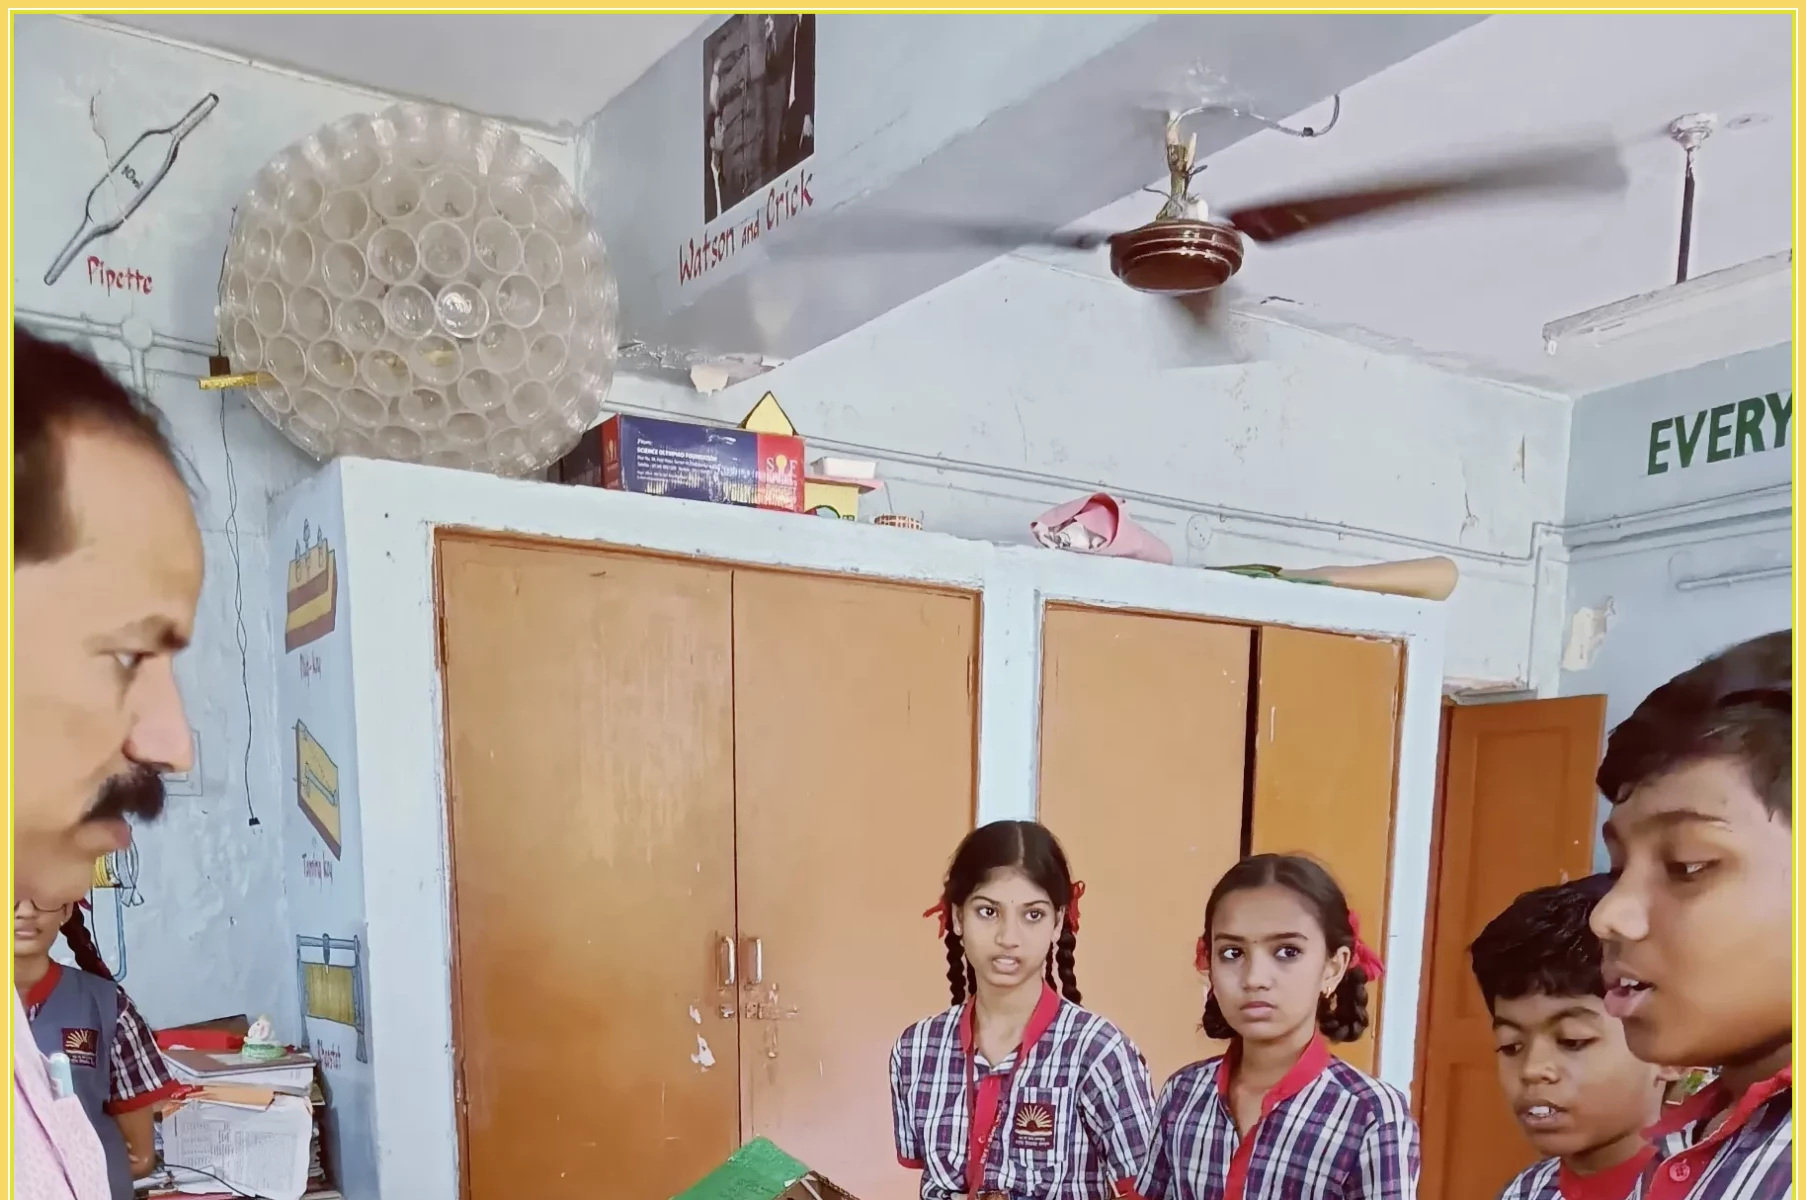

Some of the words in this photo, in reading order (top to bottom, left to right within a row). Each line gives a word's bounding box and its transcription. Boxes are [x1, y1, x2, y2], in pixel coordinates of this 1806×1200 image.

[679, 227, 735, 286] Watson
[741, 208, 760, 249] and
[766, 168, 814, 231] Crick
[87, 255, 153, 298] Pipette
[637, 446, 659, 457] SCIENCE
[658, 449, 685, 459] OLYMPIAD
[1647, 392, 1792, 475] EVERY
